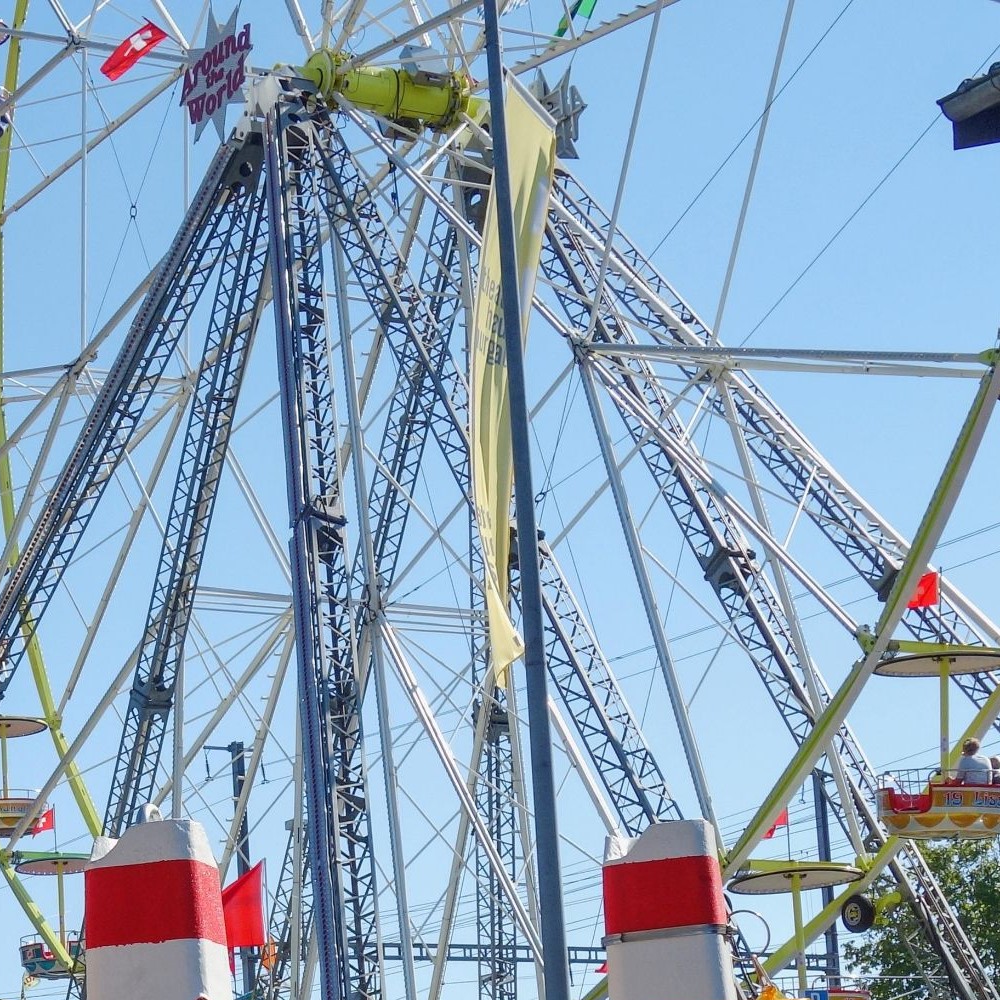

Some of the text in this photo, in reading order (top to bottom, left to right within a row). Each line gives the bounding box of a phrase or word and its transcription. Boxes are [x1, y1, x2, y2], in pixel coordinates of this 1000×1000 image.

[179, 23, 253, 107] Around
[187, 53, 246, 125] World
[944, 791, 963, 807] 19
